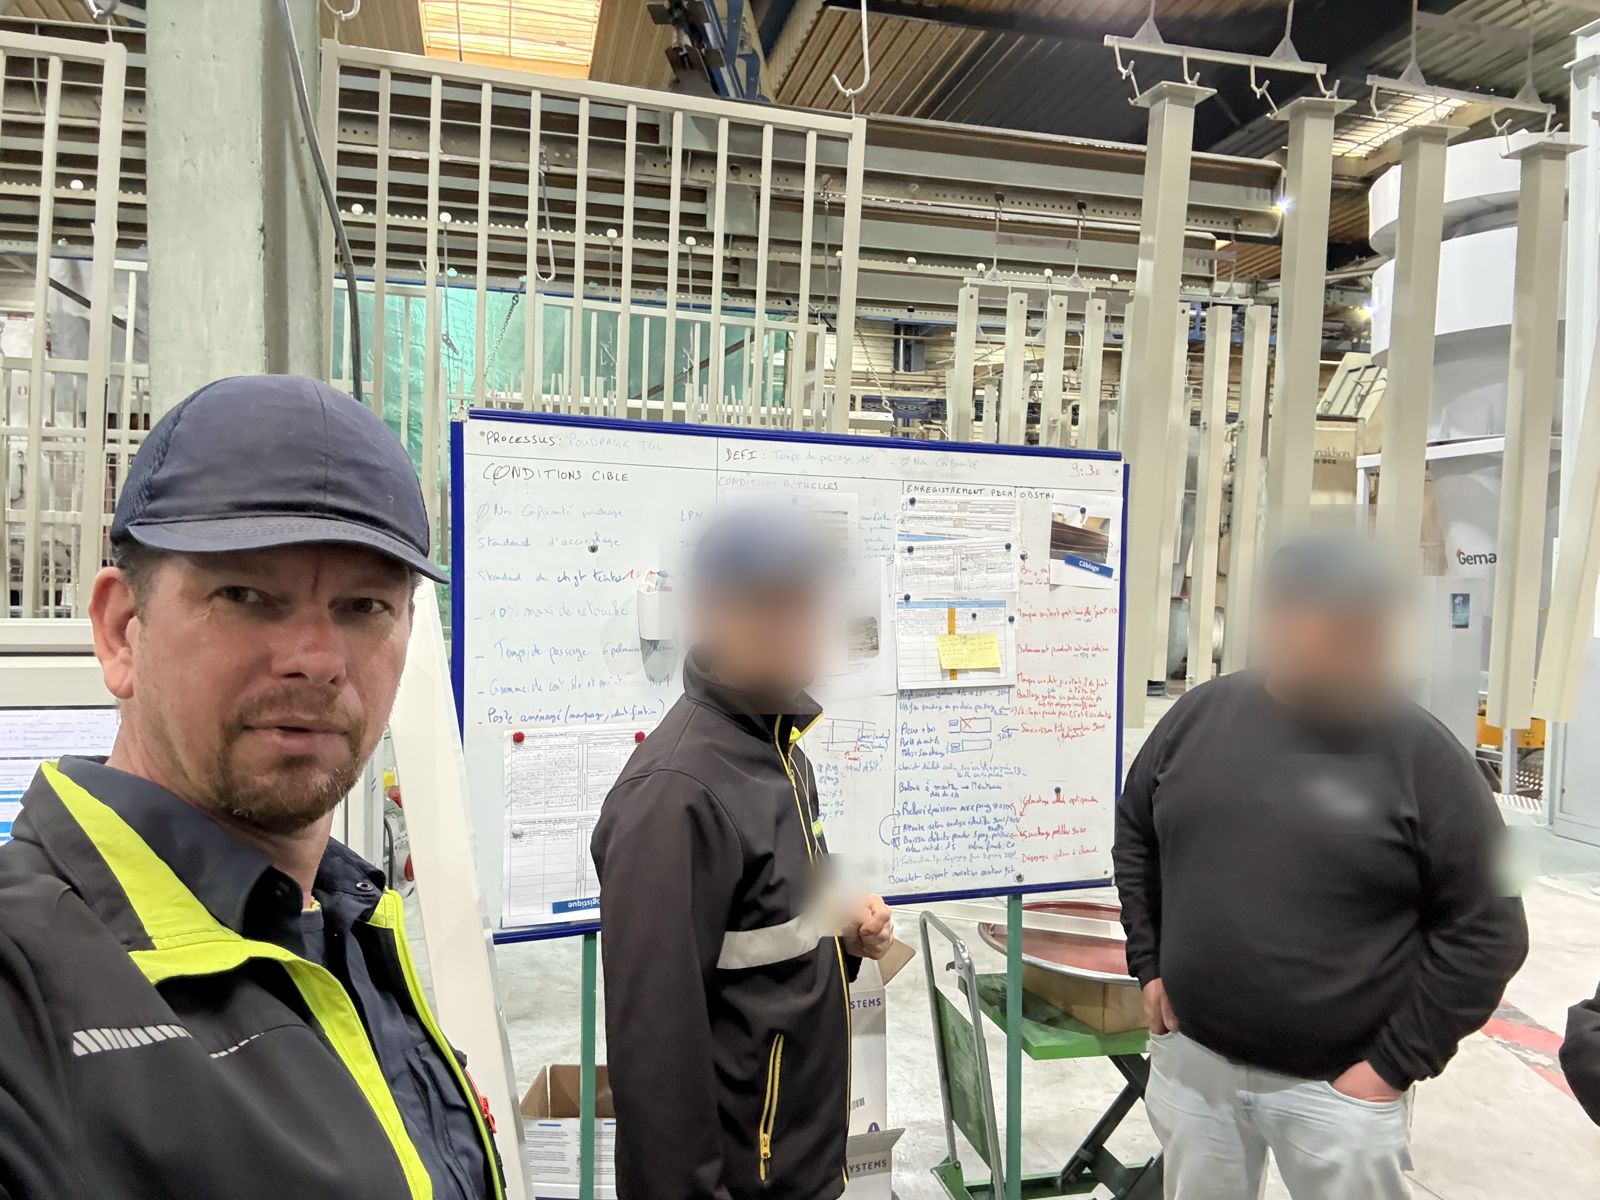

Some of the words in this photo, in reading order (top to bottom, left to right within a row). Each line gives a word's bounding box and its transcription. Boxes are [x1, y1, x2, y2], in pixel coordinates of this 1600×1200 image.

[591, 469, 630, 483] CIBLE
[1457, 551, 1498, 566] Gema
[850, 997, 882, 1010] STEMS
[849, 1159, 887, 1173] YSTEMS
